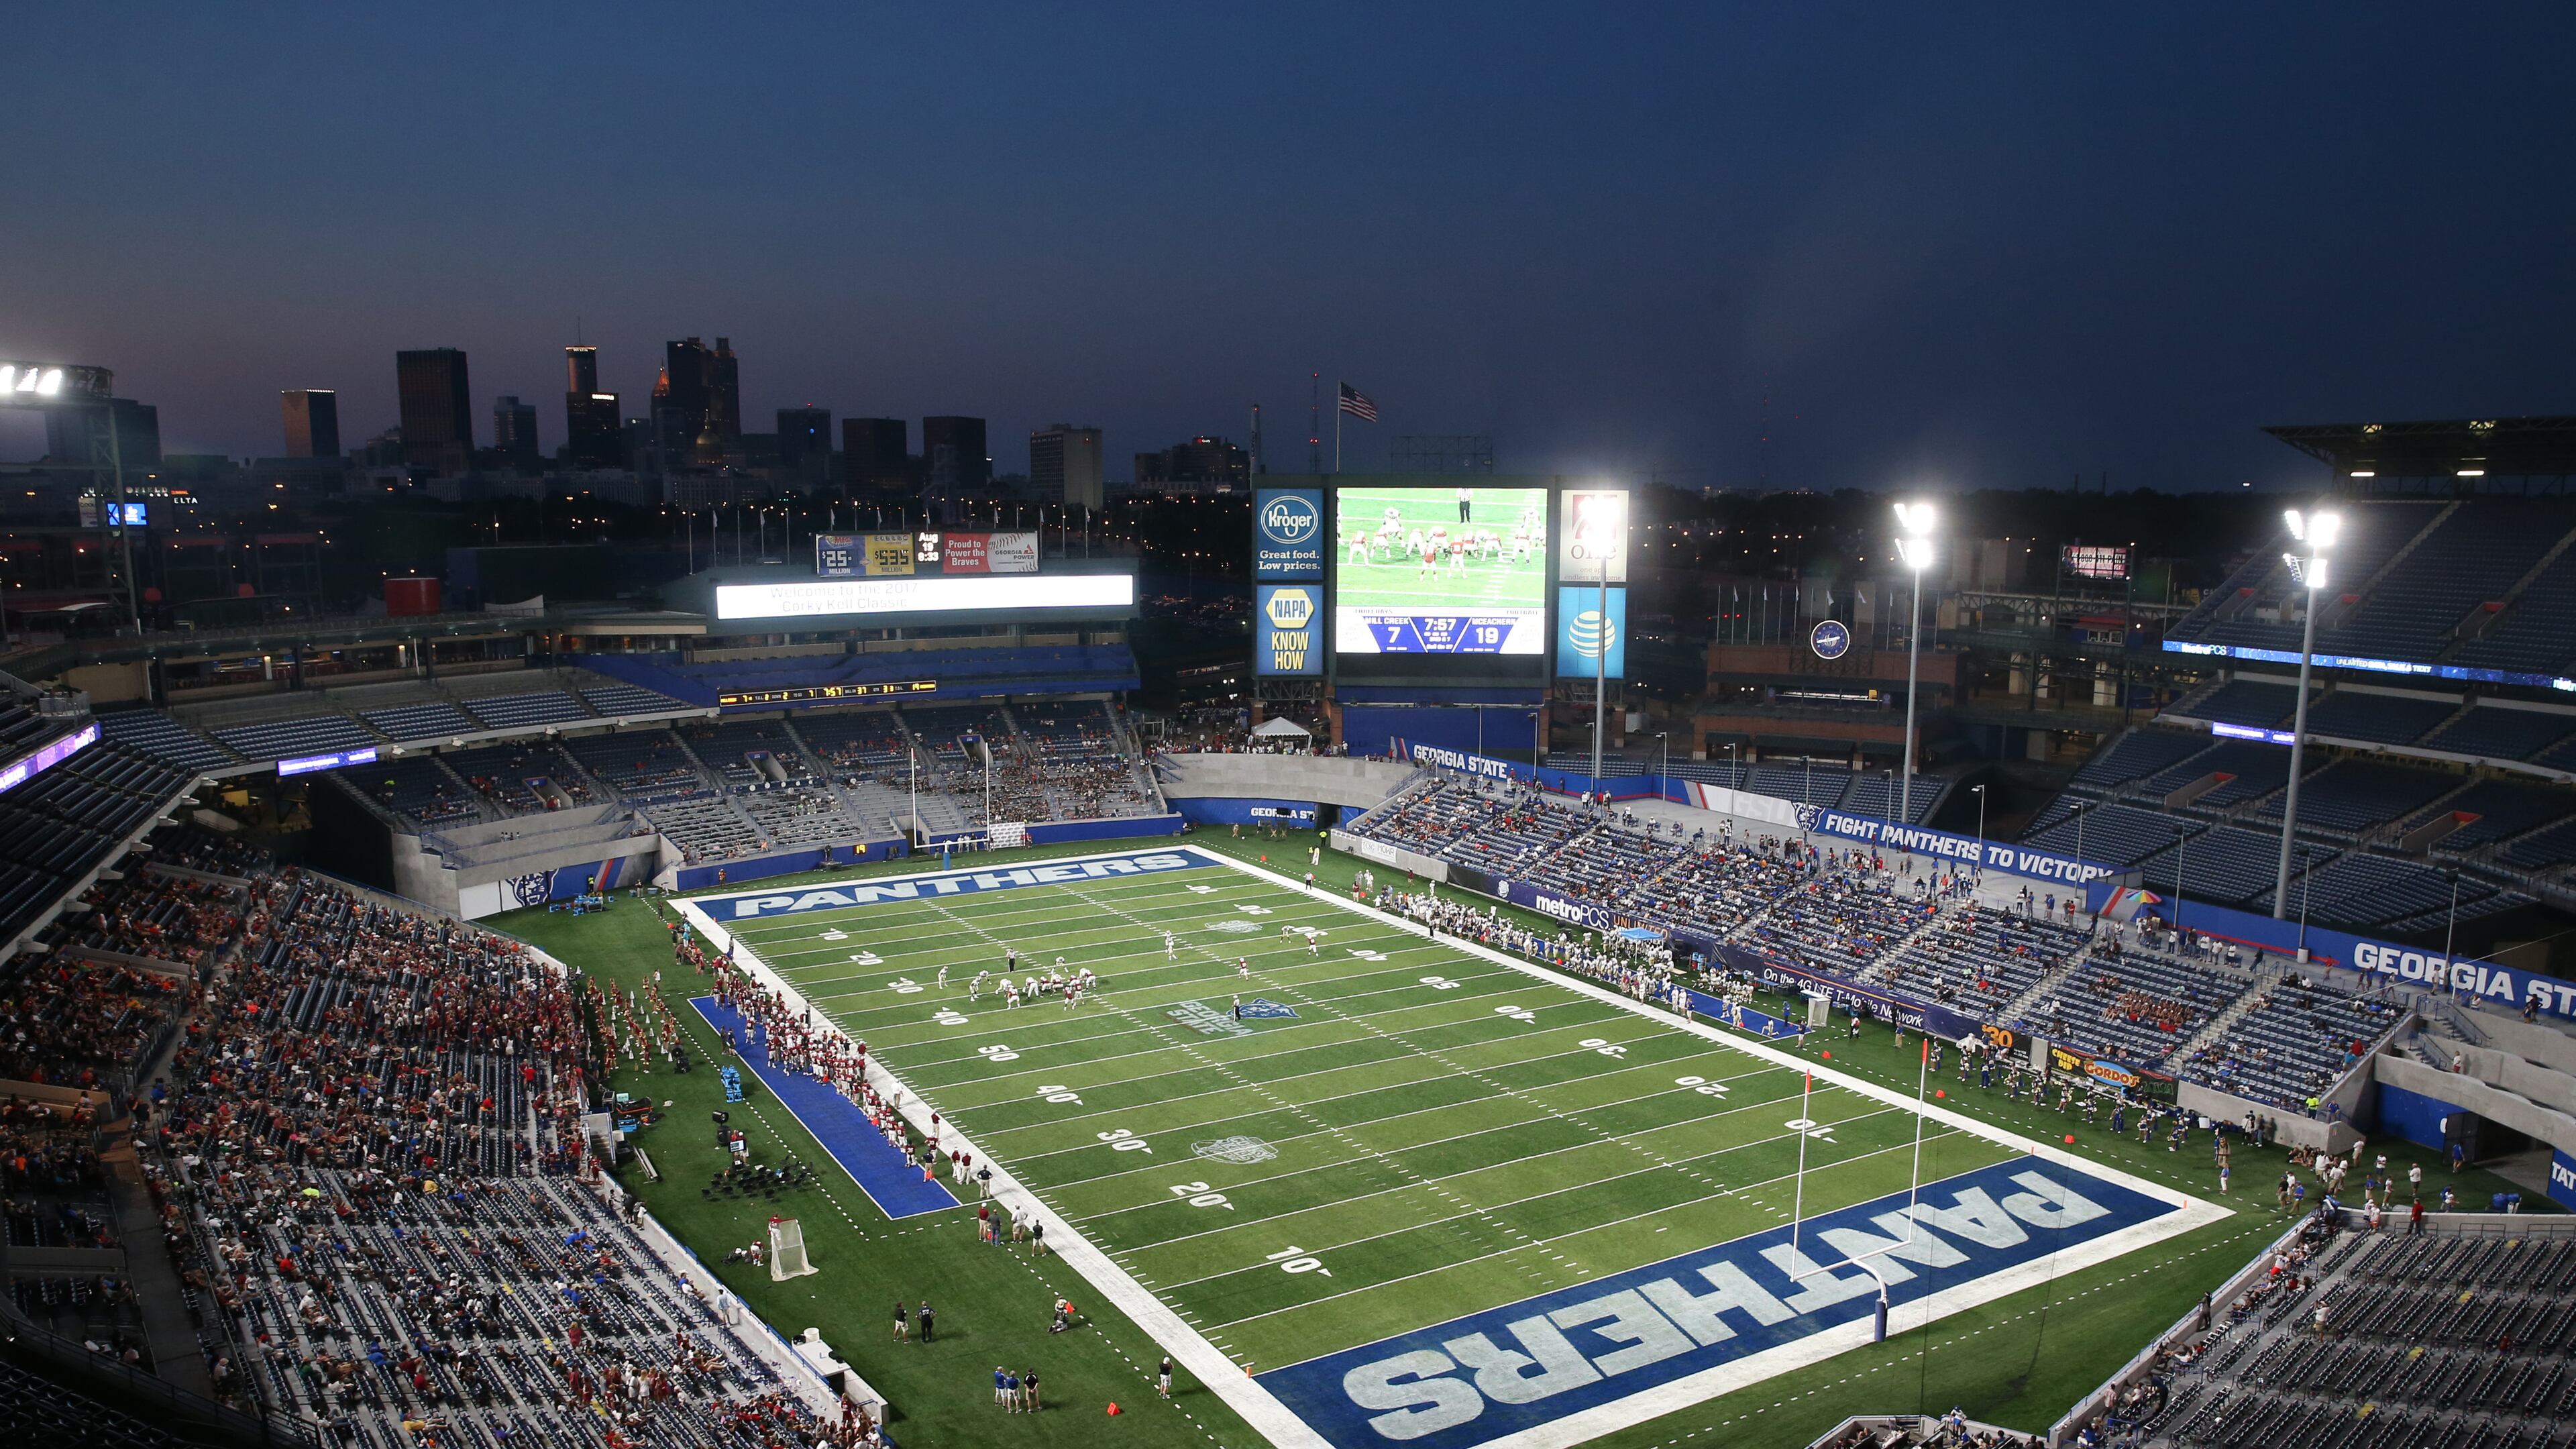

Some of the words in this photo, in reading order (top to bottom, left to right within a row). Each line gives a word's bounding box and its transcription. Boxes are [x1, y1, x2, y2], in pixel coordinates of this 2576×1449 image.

[1268, 504, 1313, 537] Kroger
[918, 532, 938, 543] Aug
[949, 539, 971, 549] Proud
[973, 541, 981, 549] to
[922, 543, 934, 551] 19
[945, 549, 971, 557] Power
[973, 549, 985, 557] the
[1260, 550, 1291, 559] Great
[1292, 550, 1320, 559] food.
[952, 557, 979, 566] Braves
[1258, 561, 1281, 570] Low
[1283, 561, 1320, 572] prices.
[771, 586, 835, 598] Welcome
[840, 586, 853, 596] to
[859, 584, 881, 595] the
[885, 582, 918, 594] 2017
[782, 600, 822, 612] Corky
[827, 598, 853, 610] Kell
[857, 598, 907, 609] Classic
[1275, 600, 1306, 618] NAPA
[1424, 618, 1457, 631] 7:57
[1271, 631, 1309, 651] KNOW
[1387, 627, 1401, 643] 7
[1476, 627, 1499, 644] 19
[1275, 651, 1304, 670] HOW
[2336, 657, 2367, 667] UNLIMITED
[823, 686, 842, 697] 7:57
[857, 686, 867, 694] 37
[1413, 744, 1466, 770] GEORGIA
[1468, 755, 1507, 779] STATE
[855, 844, 866, 854] 19
[1825, 814, 1878, 839] FIGHT
[1880, 825, 1982, 861] PANTHERS
[1988, 846, 2014, 867] TO
[2019, 853, 2114, 885] VICTORY
[735, 853, 1189, 917] PANTHERS
[1237, 904, 1273, 915] 20
[849, 953, 884, 965] 20
[1351, 949, 1388, 961] 40
[888, 979, 924, 994] 30
[1418, 975, 1461, 990] 50
[1764, 968, 1777, 982] On
[1778, 973, 1794, 984] the
[1797, 978, 1812, 991] 4G
[1814, 983, 1833, 998] LTE
[2353, 942, 2514, 1002] GEORGIA
[2526, 979, 2576, 1016] ST
[932, 1010, 969, 1026] 40
[1179, 1002, 1254, 1036] GEORGIA
[1494, 1005, 1536, 1020] 40
[1167, 1010, 1225, 1035] STATE
[1981, 1023, 2013, 1049] $30
[977, 1044, 1020, 1062] 50
[1578, 1038, 1628, 1055] 30
[2051, 1049, 2081, 1067] CHEESE
[2057, 1059, 2073, 1071] DIP
[2084, 1061, 2139, 1087] GORDO'S
[1674, 1075, 1730, 1095] 20
[1036, 1084, 1079, 1104] 40
[1784, 1118, 1838, 1140] 10
[1096, 1128, 1148, 1151] 30
[1169, 1181, 1228, 1208] 20
[1265, 1245, 1323, 1274] 10
[1342, 1168, 2112, 1442] PANTHERS
